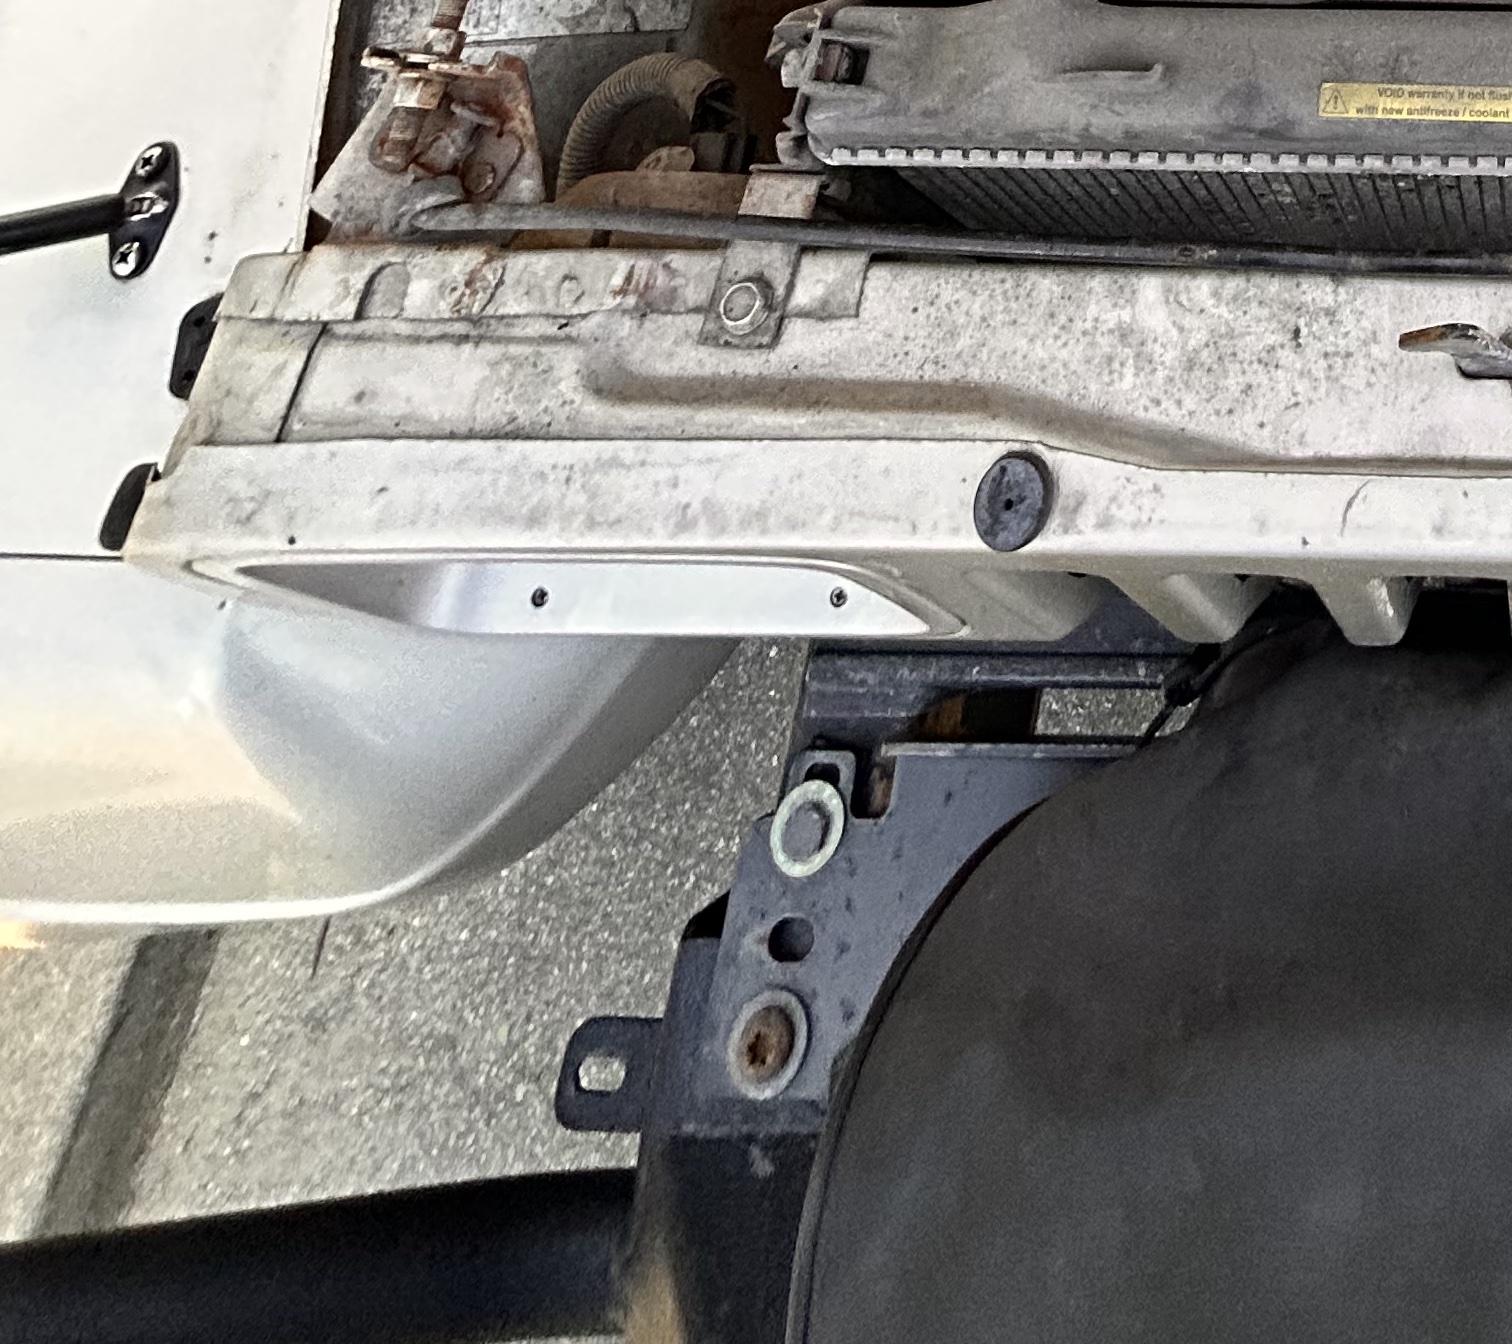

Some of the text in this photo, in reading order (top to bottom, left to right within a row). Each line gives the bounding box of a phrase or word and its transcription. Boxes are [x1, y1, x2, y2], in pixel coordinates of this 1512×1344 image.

[1377, 87, 1405, 98] VOID
[1408, 89, 1455, 101] warranty
[1467, 90, 1485, 100] not
[1355, 104, 1378, 114] with
[1382, 107, 1403, 115] new
[1407, 106, 1460, 117] antifreeze
[1469, 108, 1510, 118] coolant
